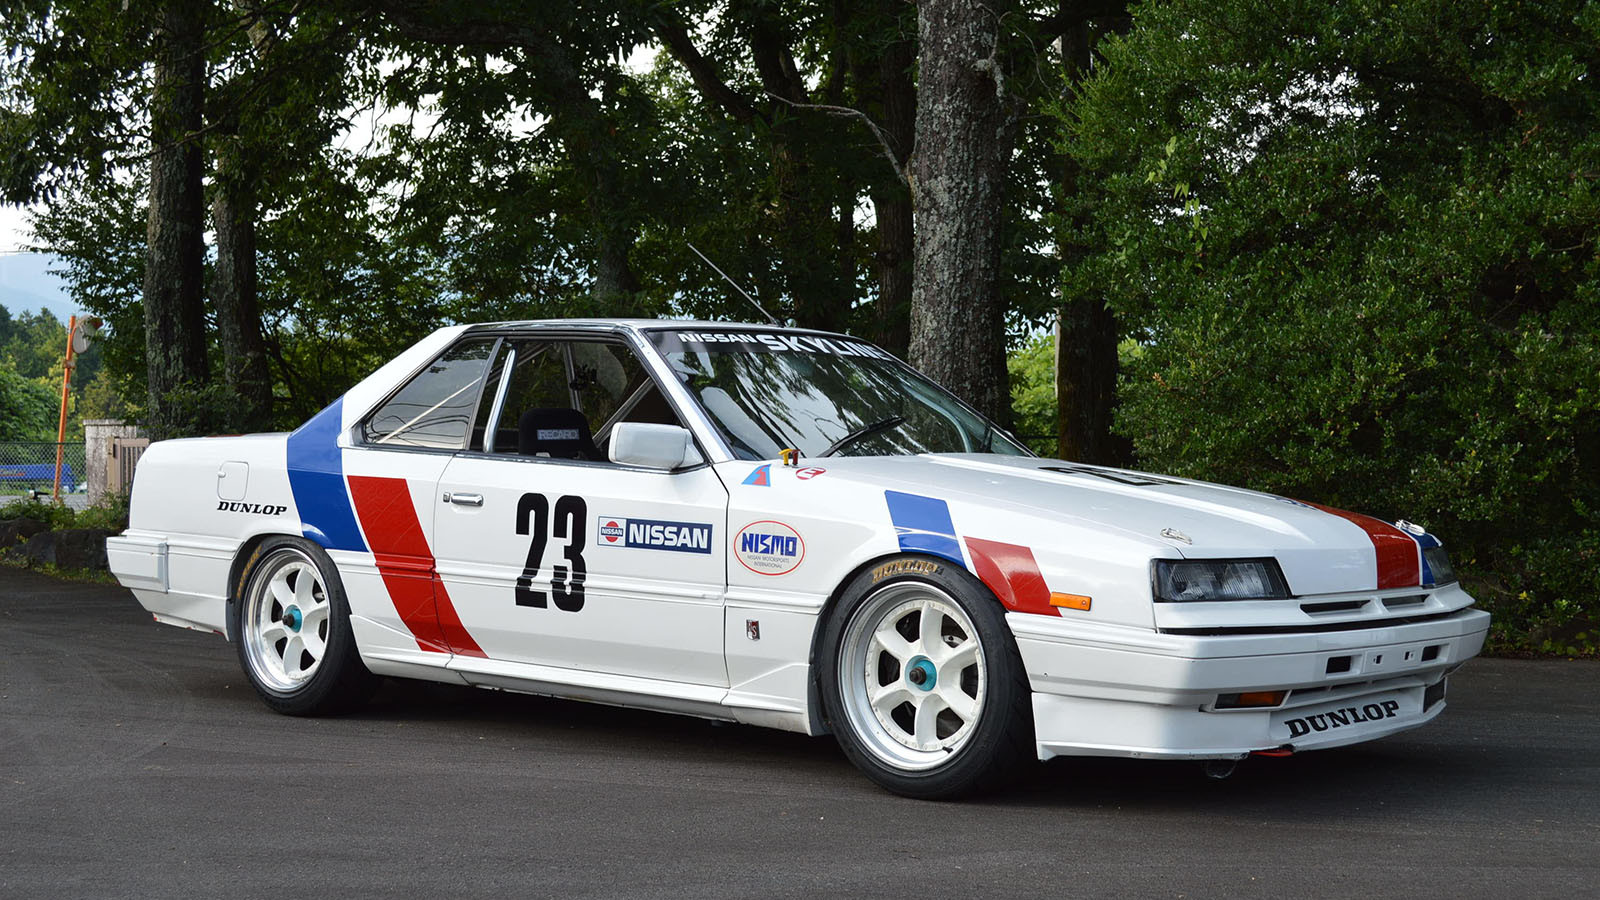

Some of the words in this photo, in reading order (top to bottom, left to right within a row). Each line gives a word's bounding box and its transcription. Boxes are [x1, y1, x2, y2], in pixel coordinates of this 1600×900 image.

[678, 333, 758, 343] NISSAN
[755, 334, 893, 361] SKYLINE
[538, 430, 579, 439] RECARO
[217, 501, 287, 515] DUNLOP
[601, 528, 623, 536] NISSAN
[629, 523, 709, 549] NISSAN
[741, 532, 798, 557] NISMO
[515, 492, 587, 613] 23
[1284, 700, 1400, 739] DUNLOP
